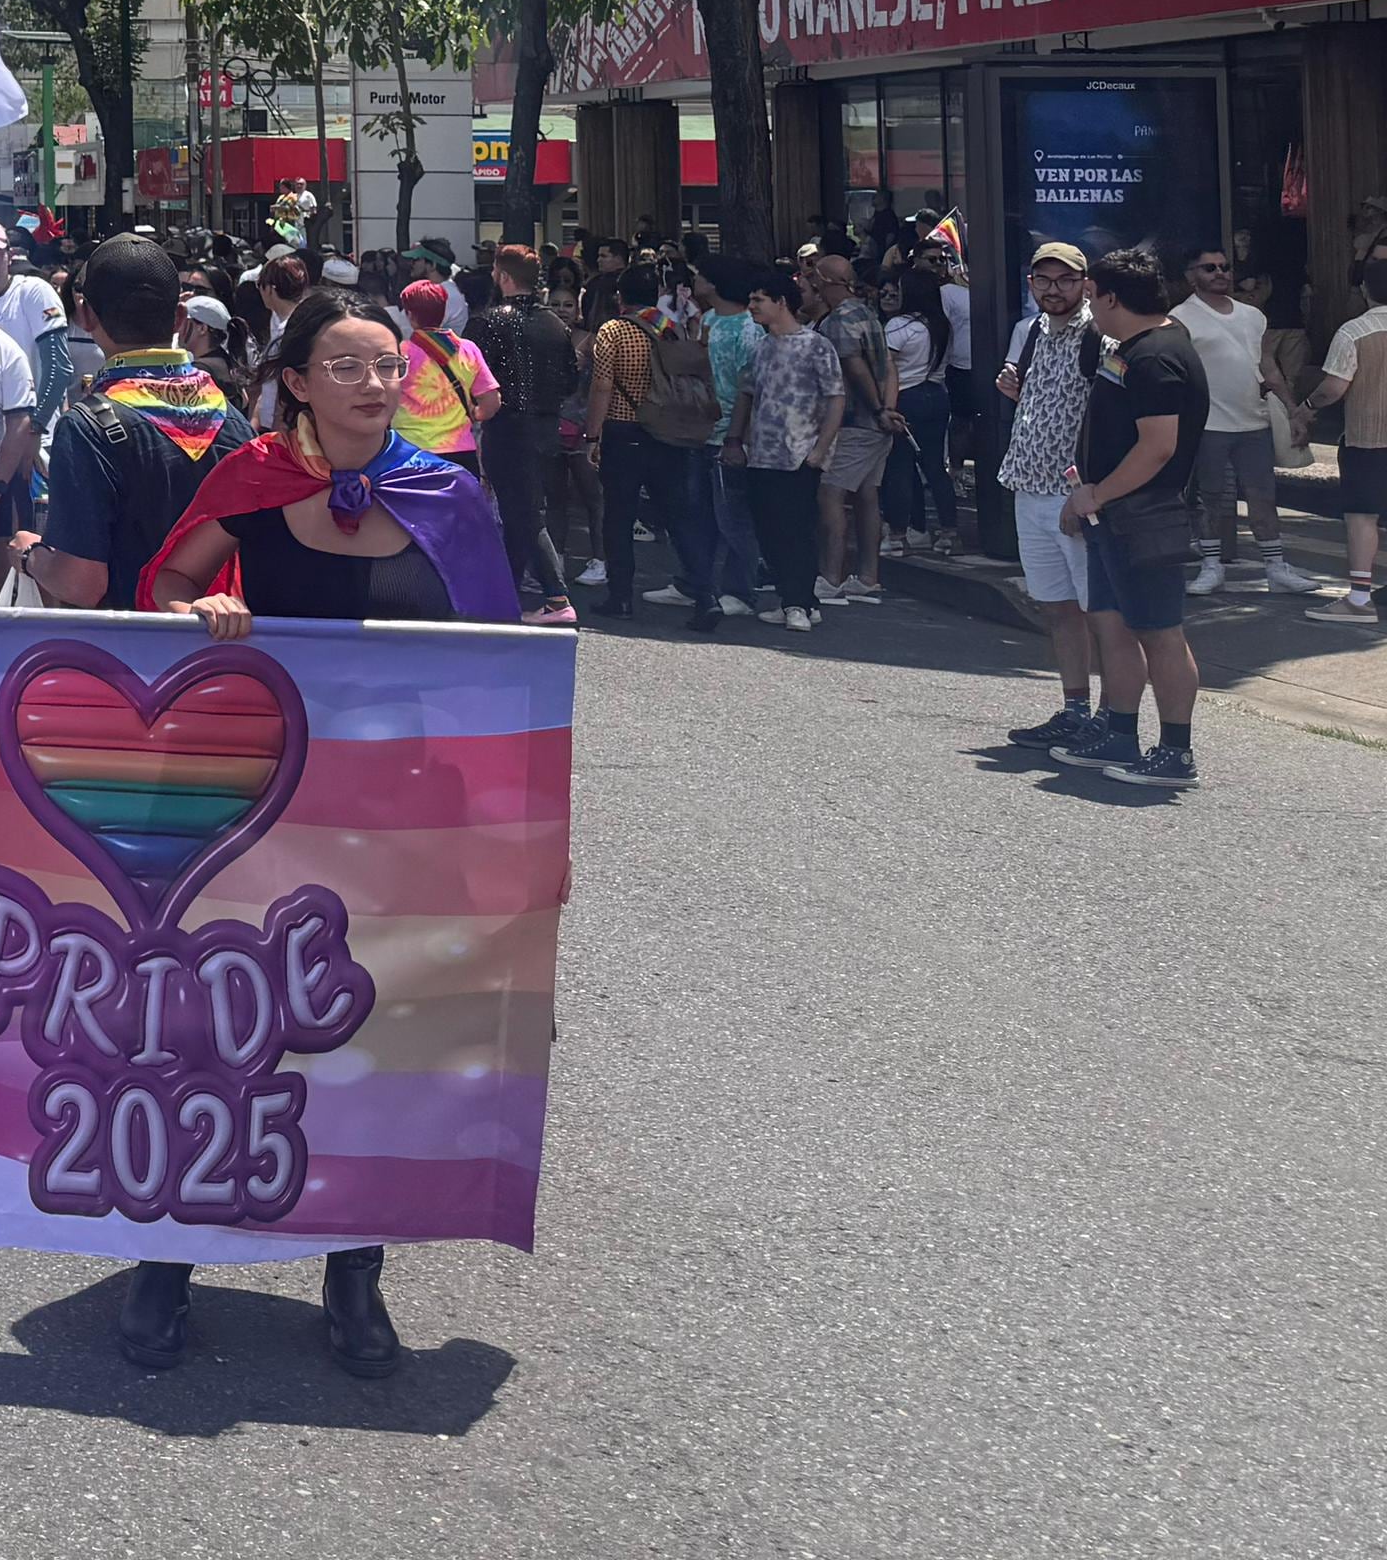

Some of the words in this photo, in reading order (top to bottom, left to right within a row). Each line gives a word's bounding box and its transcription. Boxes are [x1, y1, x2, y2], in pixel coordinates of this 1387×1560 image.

[1086, 81, 1136, 91] JCDecaux
[370, 92, 405, 107] Purdy
[409, 91, 447, 105] Motor
[472, 140, 511, 164] pm
[1034, 169, 1071, 182] VEN
[1073, 169, 1108, 182] POR
[1111, 169, 1144, 183] LAS
[1035, 189, 1124, 203] BALLENAS
[43, 1081, 297, 1206] 2025
